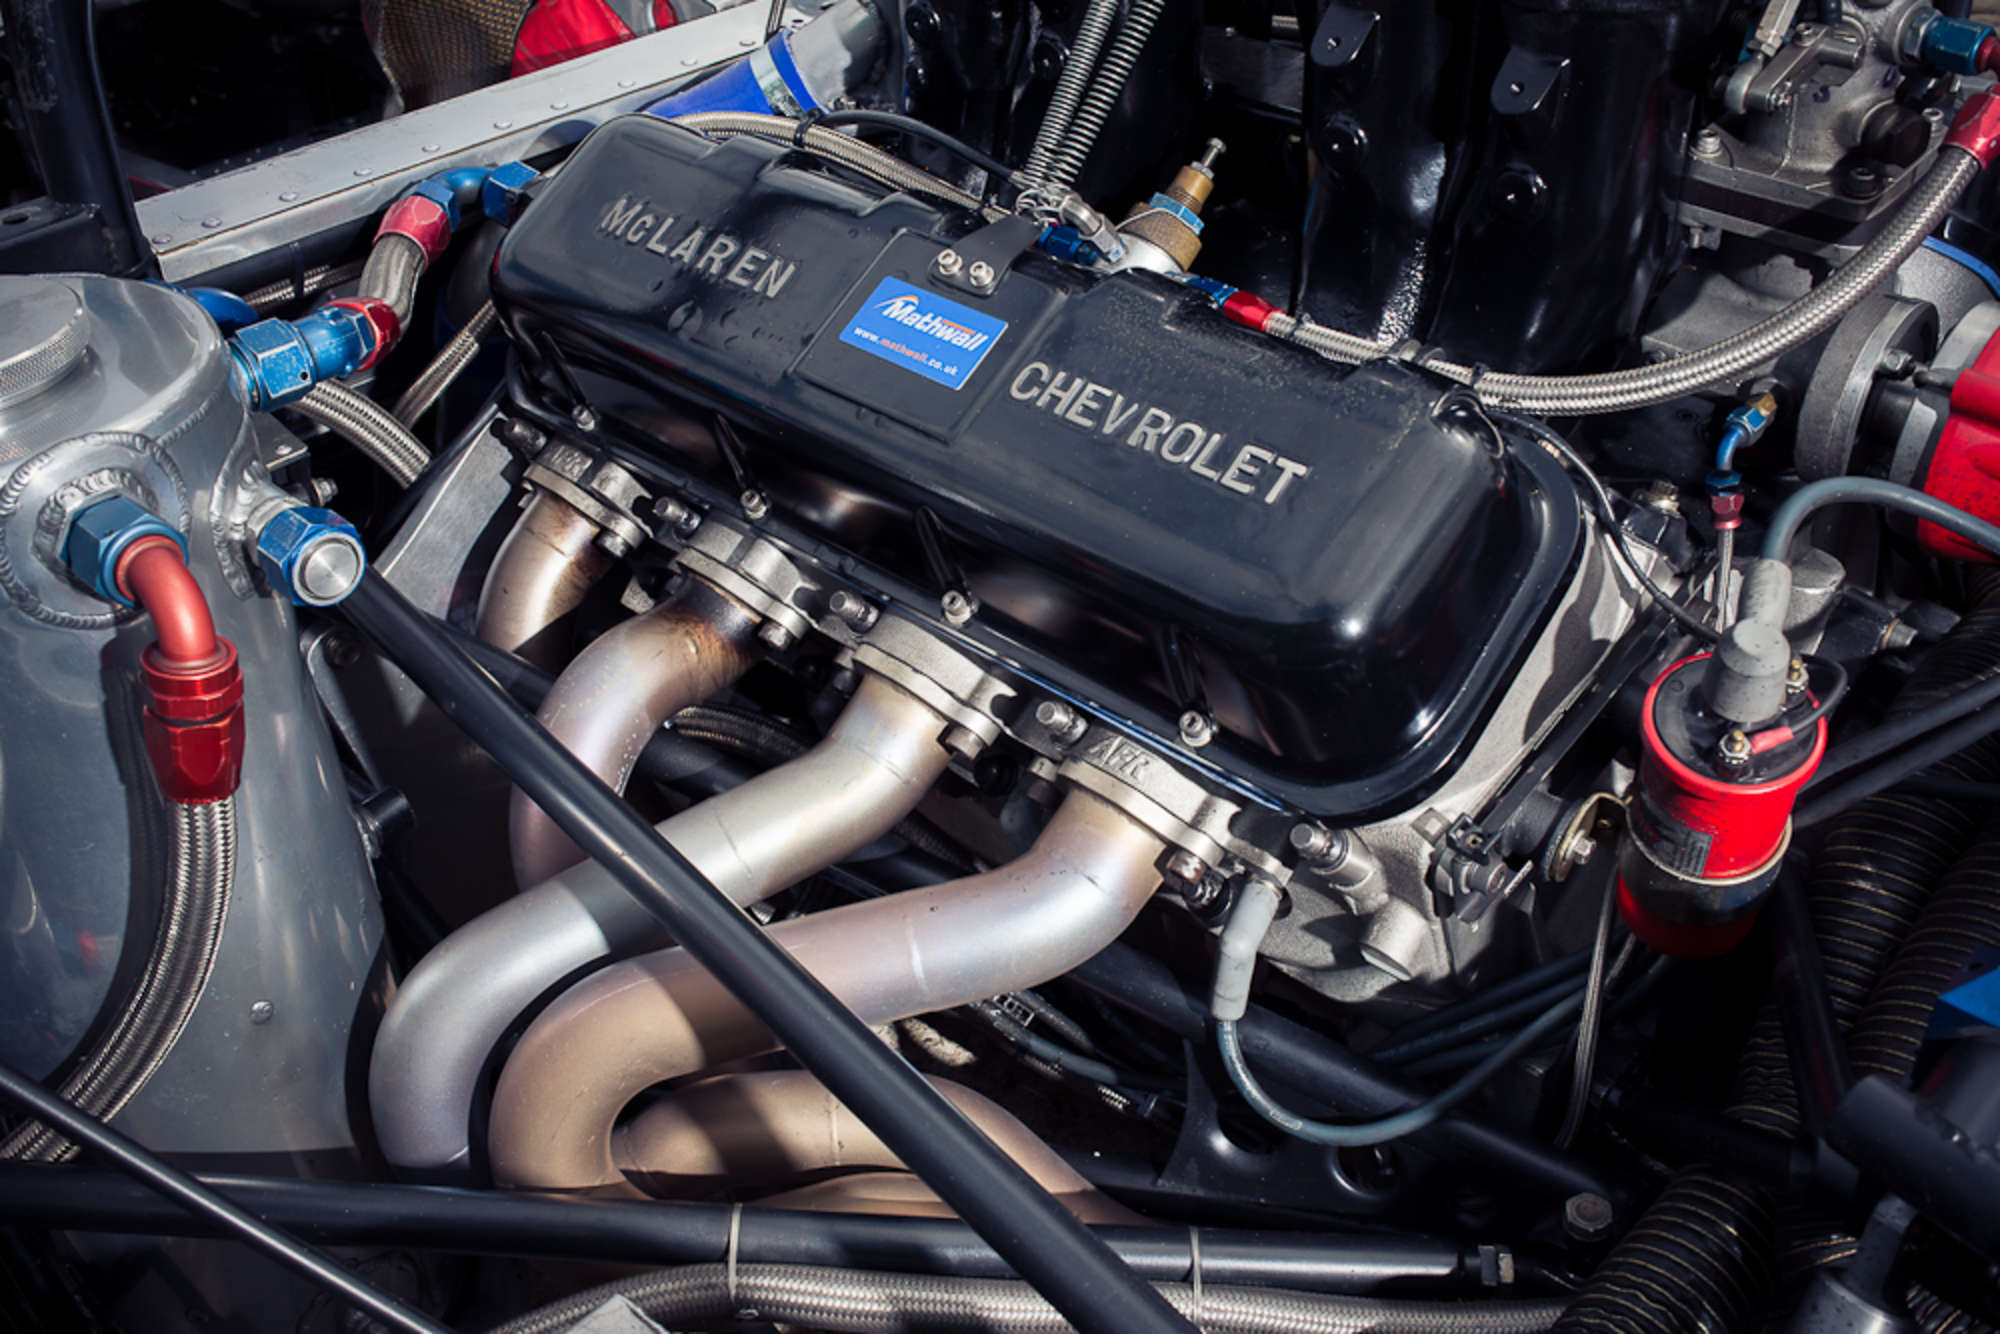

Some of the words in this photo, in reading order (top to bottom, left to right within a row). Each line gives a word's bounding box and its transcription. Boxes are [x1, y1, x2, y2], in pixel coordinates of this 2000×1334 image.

[601, 197, 796, 299] McLAREN
[853, 327, 958, 376] www.mathwall.co.uk
[881, 300, 990, 351] Mathwall
[1009, 361, 1308, 504] CHEVROLET
